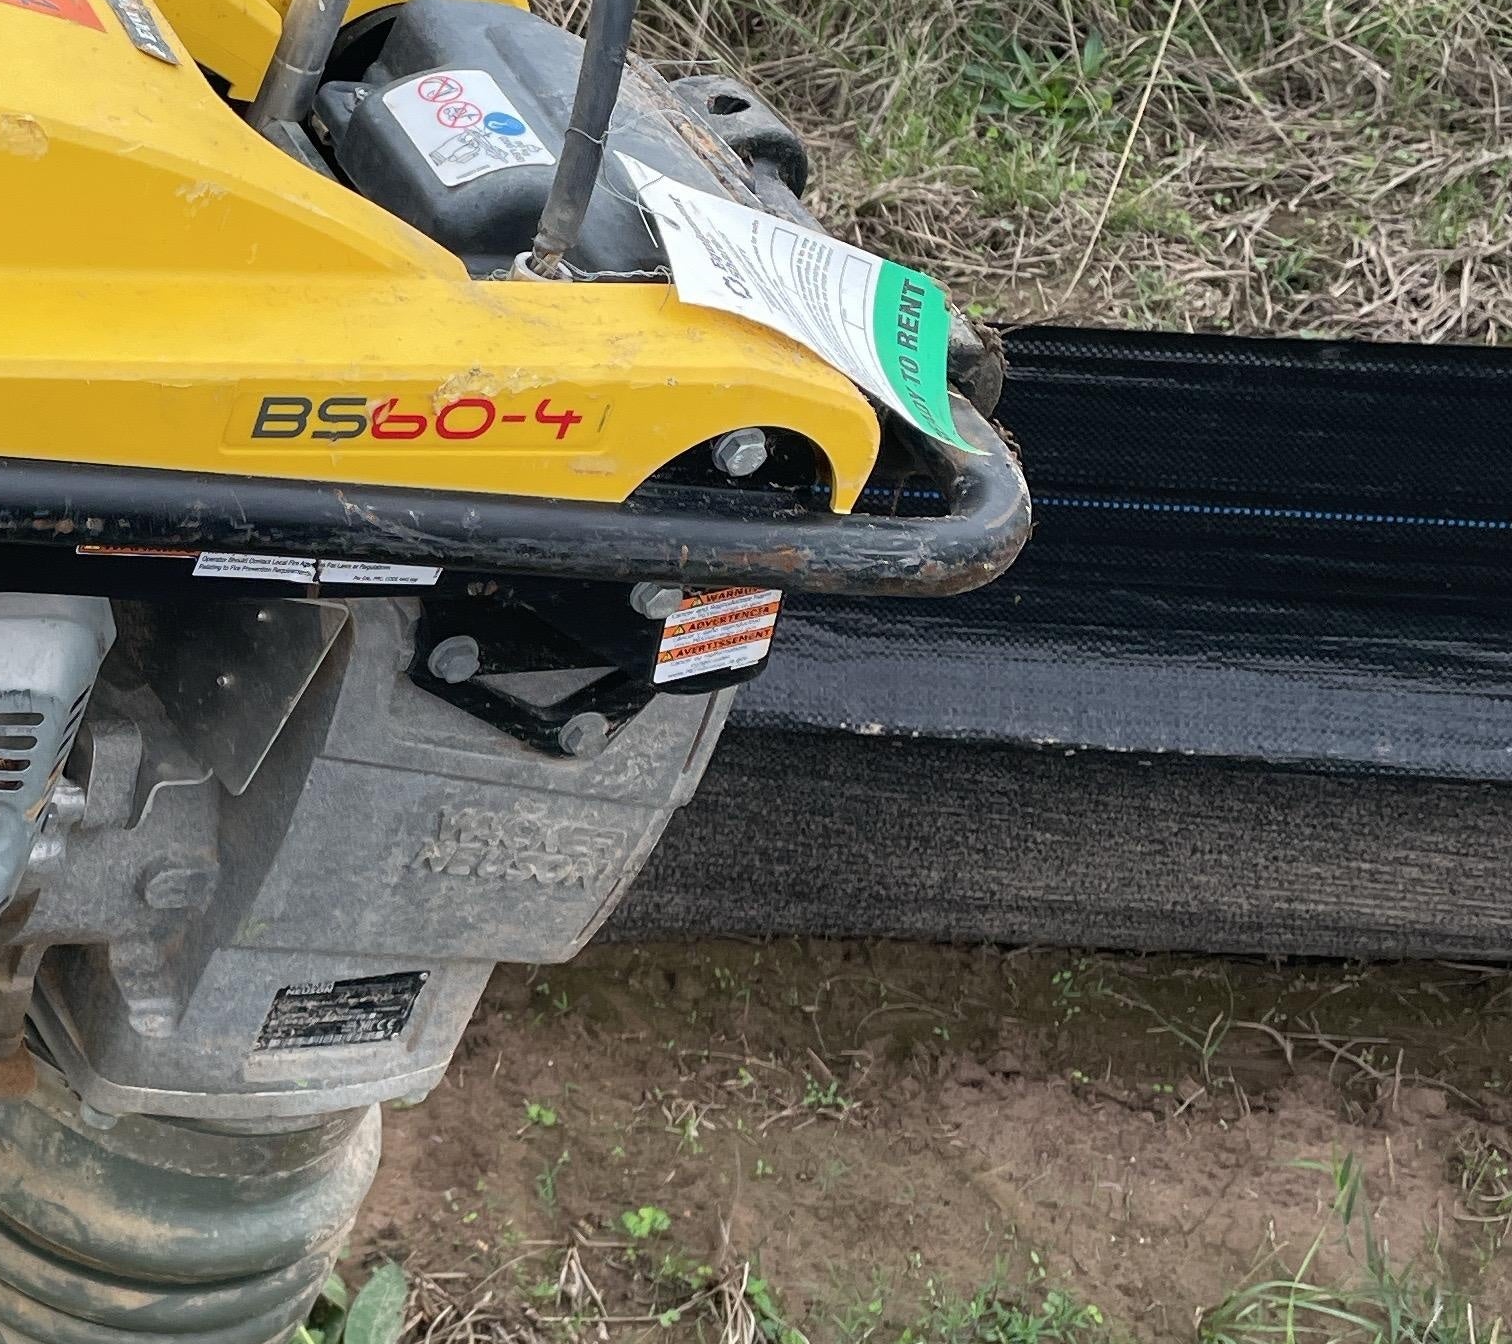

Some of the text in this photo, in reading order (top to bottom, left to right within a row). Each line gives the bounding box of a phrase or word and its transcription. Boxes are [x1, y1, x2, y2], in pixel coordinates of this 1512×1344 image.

[895, 278, 926, 352] RENT
[898, 356, 921, 384] TO
[250, 396, 583, 441] BS60-4
[272, 558, 288, 566] Local
[288, 559, 300, 567] Fire
[688, 606, 770, 632] ADVERTENCIA
[676, 629, 771, 658] AVERTISSEMENT
